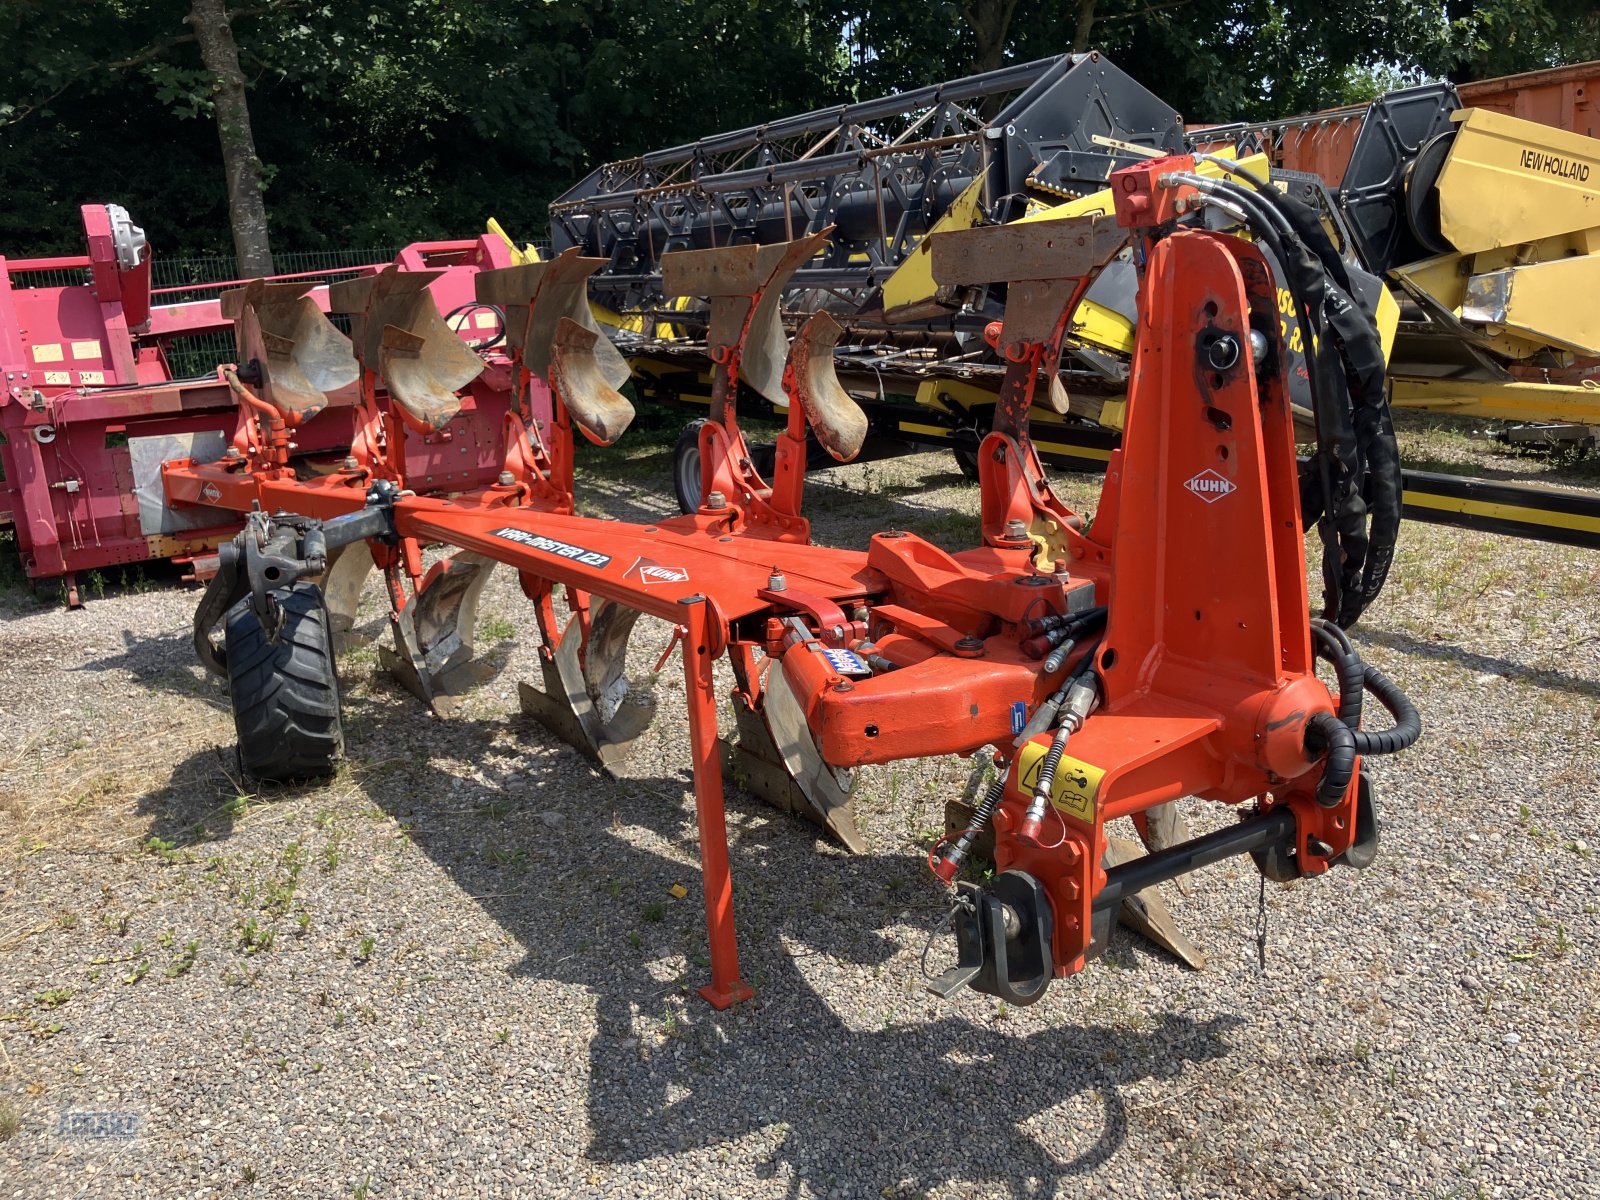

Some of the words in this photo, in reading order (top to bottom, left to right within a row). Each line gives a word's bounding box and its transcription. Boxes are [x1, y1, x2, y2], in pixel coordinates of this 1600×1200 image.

[1520, 149, 1544, 171] NEW
[1543, 155, 1590, 182] HOLLAND
[1190, 479, 1230, 493] KUHN
[496, 527, 585, 558] VARI-MASTER
[576, 552, 610, 566] 123
[643, 566, 686, 581] KUHN
